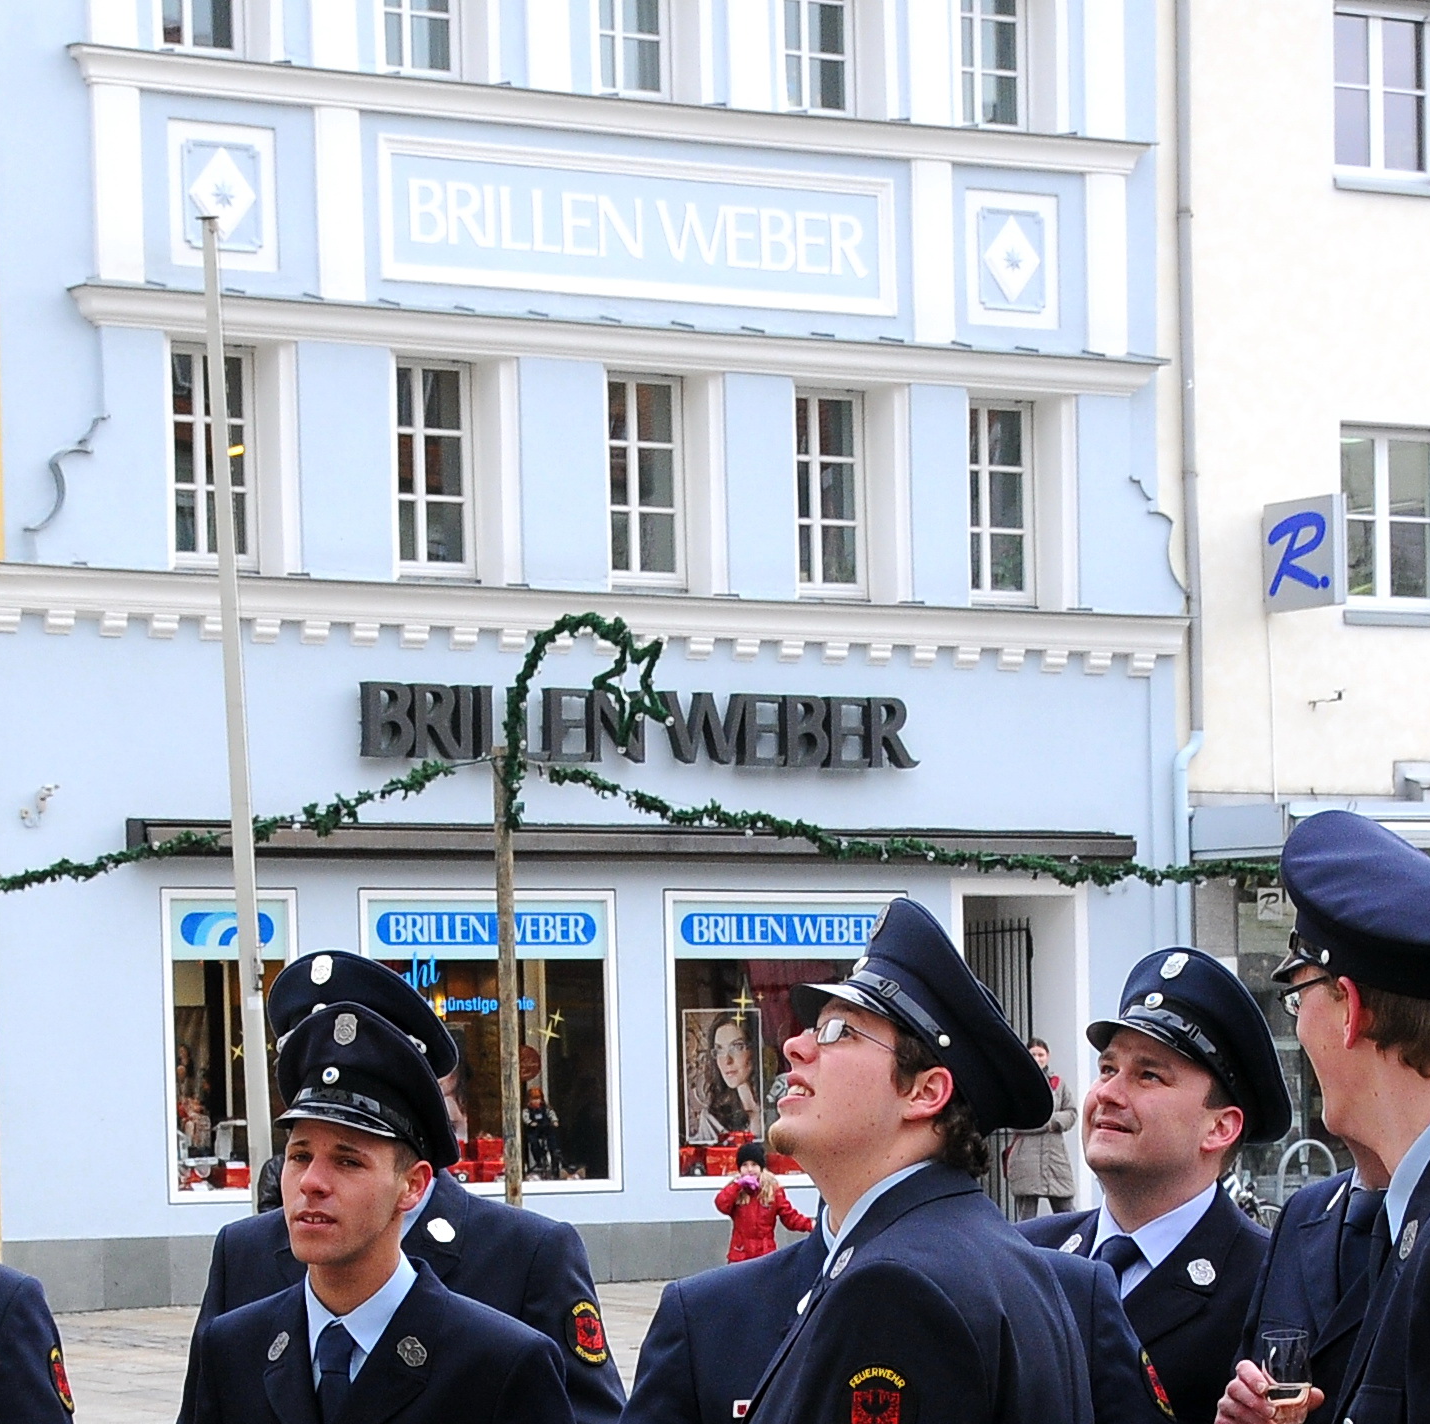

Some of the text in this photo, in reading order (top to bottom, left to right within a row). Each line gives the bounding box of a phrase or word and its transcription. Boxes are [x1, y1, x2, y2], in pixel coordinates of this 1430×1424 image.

[407, 178, 869, 279] BRILLEN WEBER
[657, 690, 921, 769] WEBER
[388, 913, 491, 944] BRILLEN
[692, 915, 787, 944] BRILLEN
[848, 1367, 906, 1389] FEUERWEHR
